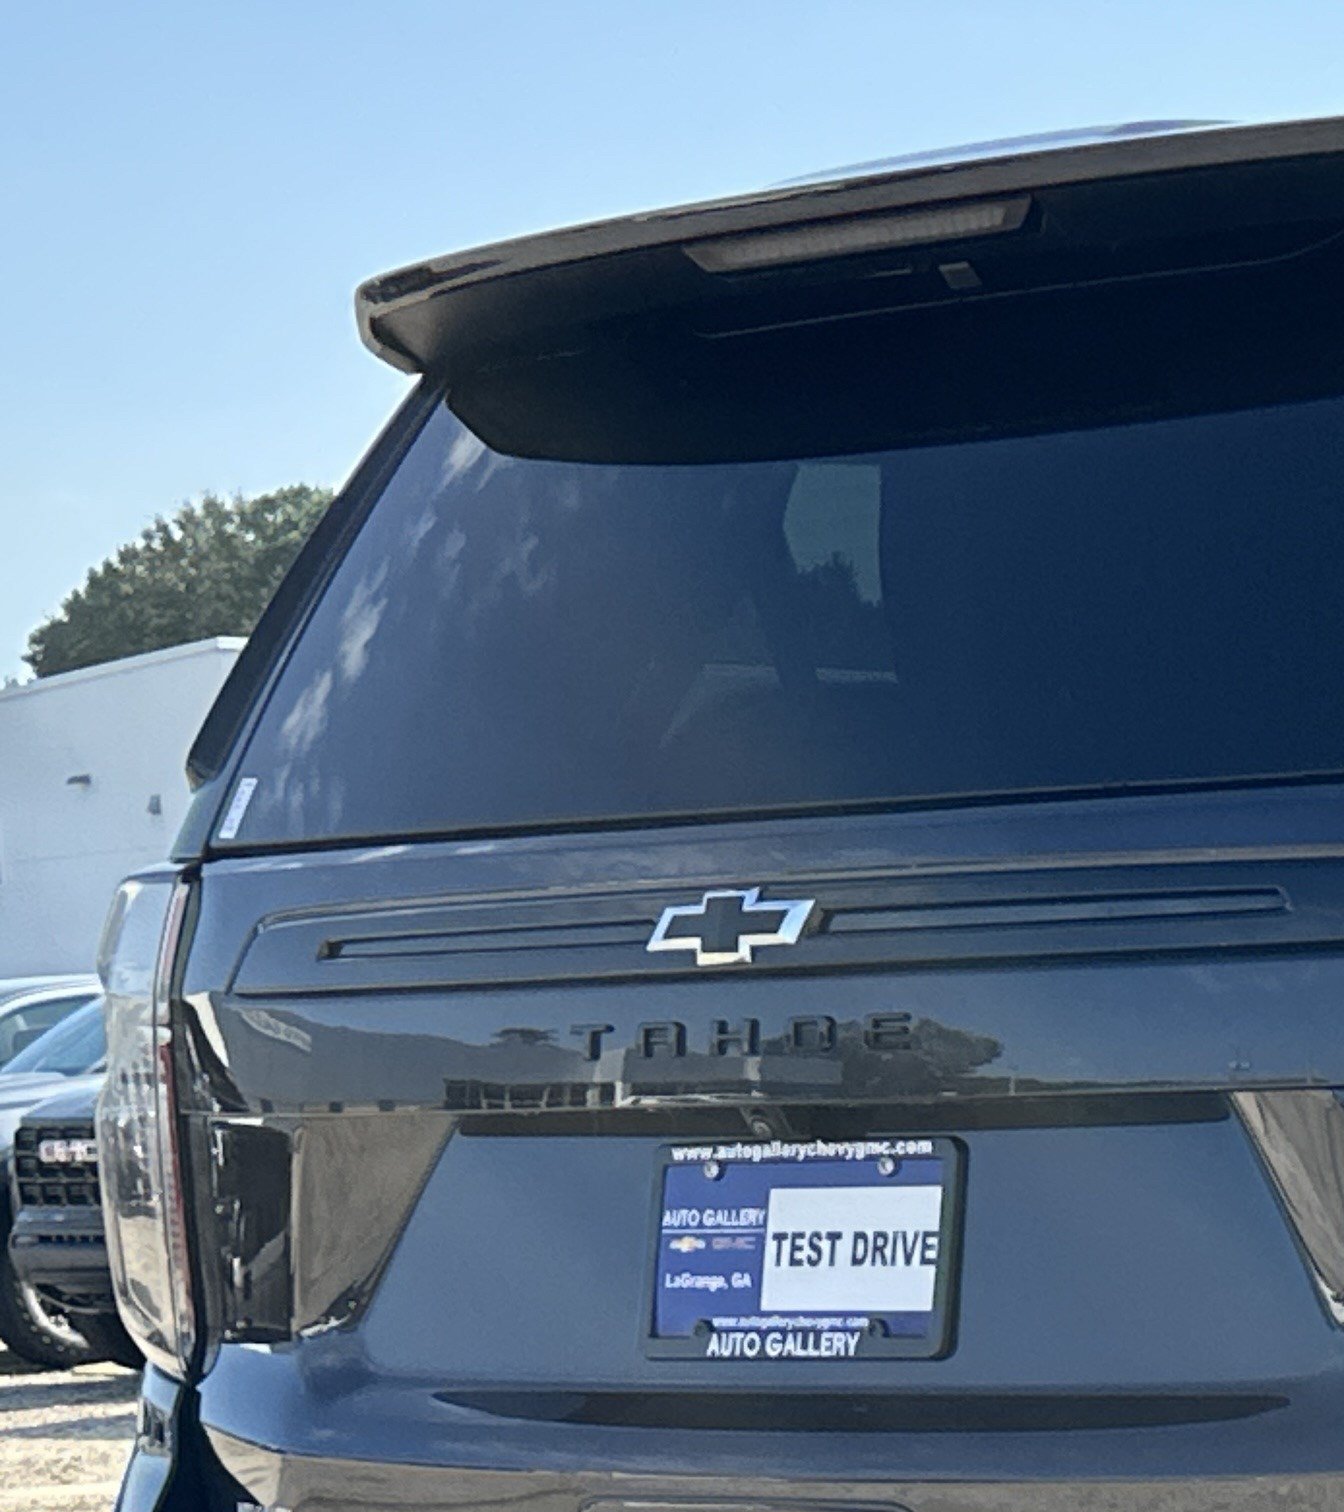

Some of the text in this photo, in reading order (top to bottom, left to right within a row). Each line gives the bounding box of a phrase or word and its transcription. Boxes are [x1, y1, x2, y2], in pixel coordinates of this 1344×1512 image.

[570, 1010, 914, 1062] TAHOE
[662, 1207, 766, 1228] AUTO GALLERY
[772, 1230, 939, 1268] TEST DRIVE
[731, 1271, 752, 1289] GA
[706, 1331, 861, 1357] AUTO GALLERY
